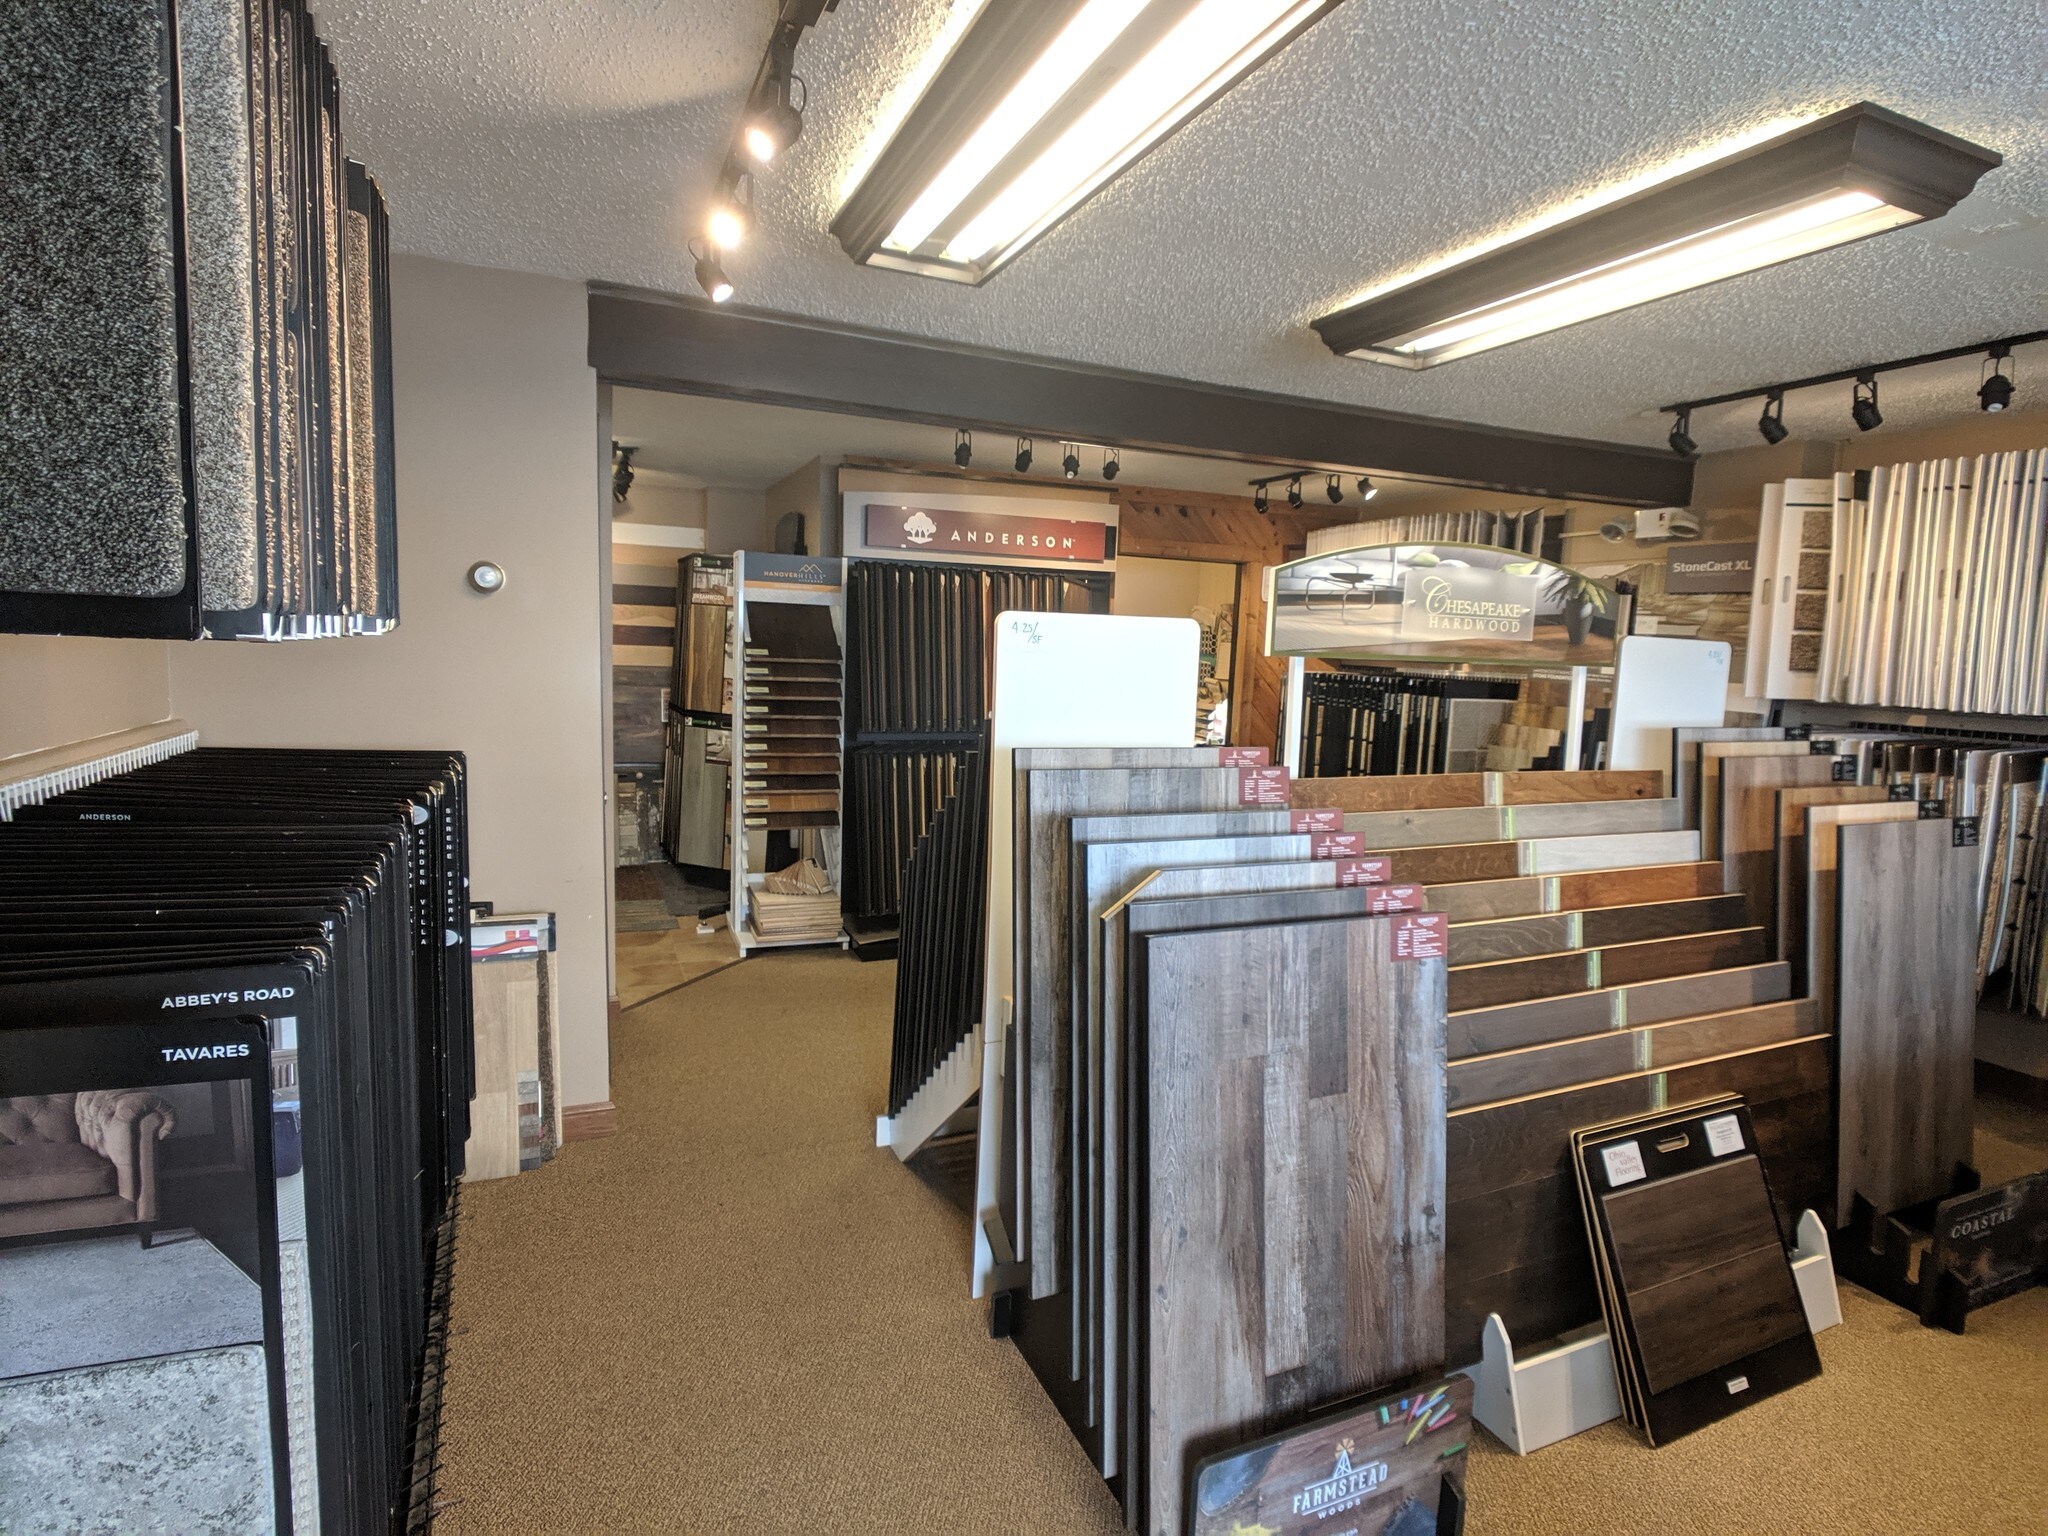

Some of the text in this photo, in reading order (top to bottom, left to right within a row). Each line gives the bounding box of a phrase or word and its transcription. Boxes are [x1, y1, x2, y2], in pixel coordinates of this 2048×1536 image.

[951, 530, 1073, 550] ANDERSON
[1672, 560, 1752, 573] StoneCast XL
[1421, 575, 1521, 617] CHESAPEAKE
[1428, 616, 1520, 633] HARDWOOD
[79, 813, 131, 821] ANDERSON
[445, 807, 453, 860] SERENE
[161, 987, 295, 1009] ABBEY'S ROAD
[161, 1043, 250, 1062] TAVARES
[1951, 1207, 2015, 1239] COASTAL
[1293, 1463, 1389, 1514] FARMSTEAD
[1318, 1498, 1362, 1520] WOODS
